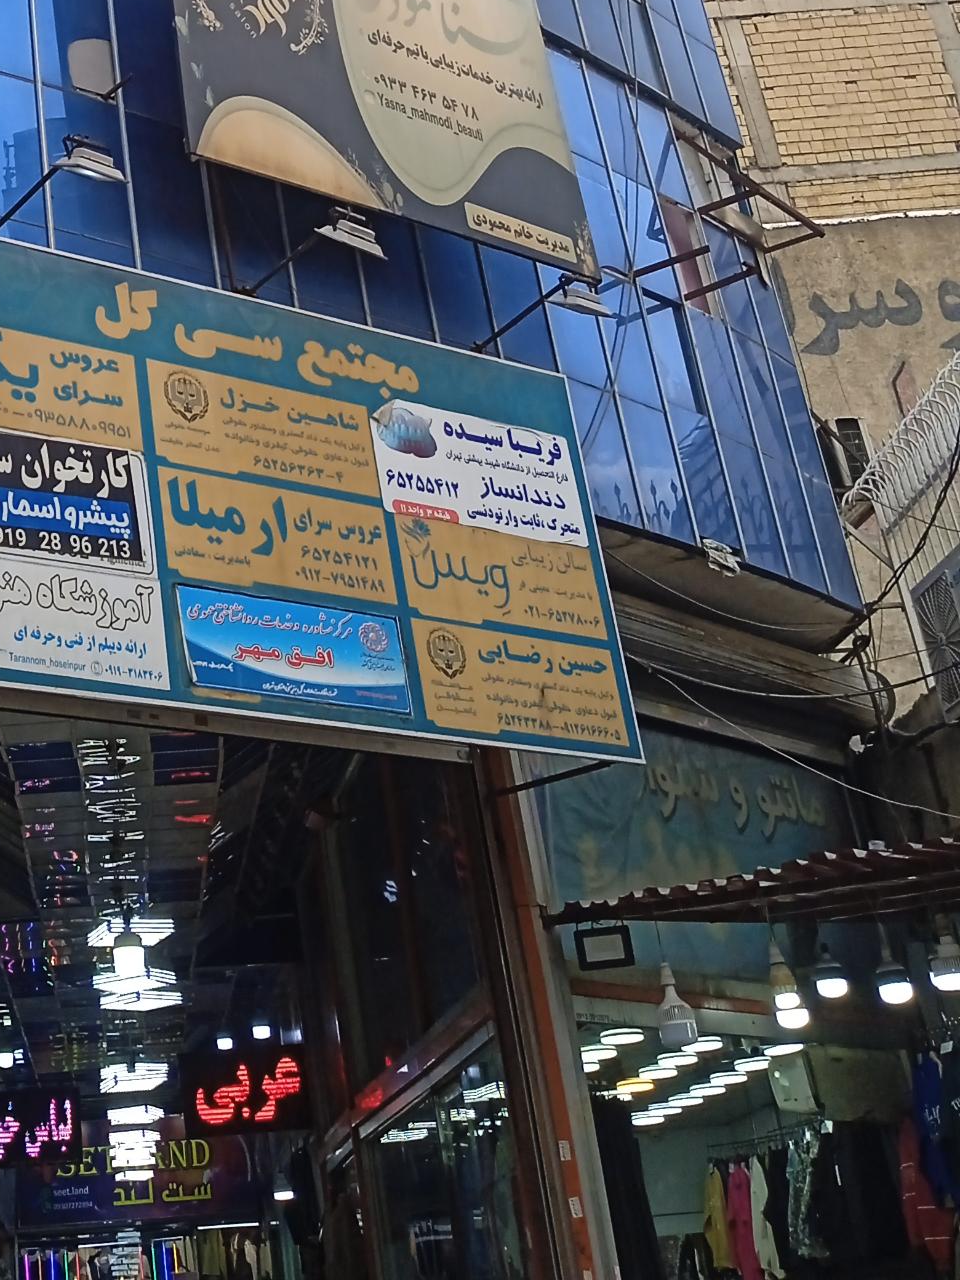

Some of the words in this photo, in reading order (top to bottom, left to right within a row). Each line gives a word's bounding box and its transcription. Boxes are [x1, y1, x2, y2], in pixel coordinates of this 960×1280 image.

[472, 213, 512, 233] محمودی
[513, 223, 534, 240] خانم
[535, 233, 571, 254] مدیریت
[95, 281, 158, 340] گل
[174, 323, 283, 361] سی
[50, 349, 120, 374] عروس
[297, 340, 419, 399] مجتمع
[53, 381, 124, 408] سرای
[220, 387, 281, 413] خزل
[287, 406, 360, 433] شاهین
[443, 420, 503, 451] سیده
[506, 426, 563, 467] فریبا
[21, 442, 130, 499] کارتخوان
[480, 475, 567, 510] دندانساز
[64, 497, 131, 539] پیشرو
[167, 475, 289, 557] ارمیلا
[293, 506, 333, 536] سرای
[38, 531, 61, 551] 28
[69, 535, 92, 555] 96
[97, 539, 131, 558] 213
[338, 524, 383, 546] عروس
[510, 543, 554, 571] زیبایی
[556, 551, 588, 574] سالن
[36, 573, 154, 631] آموزشگاه
[64, 631, 84, 648] فنی
[97, 638, 123, 657] دیپلم
[124, 642, 148, 660] ارائه
[232, 641, 283, 663] مهر
[285, 645, 335, 670] افق
[477, 639, 555, 674] رضایی
[558, 654, 608, 677] حسین
[196, 1057, 302, 1125] عربی
